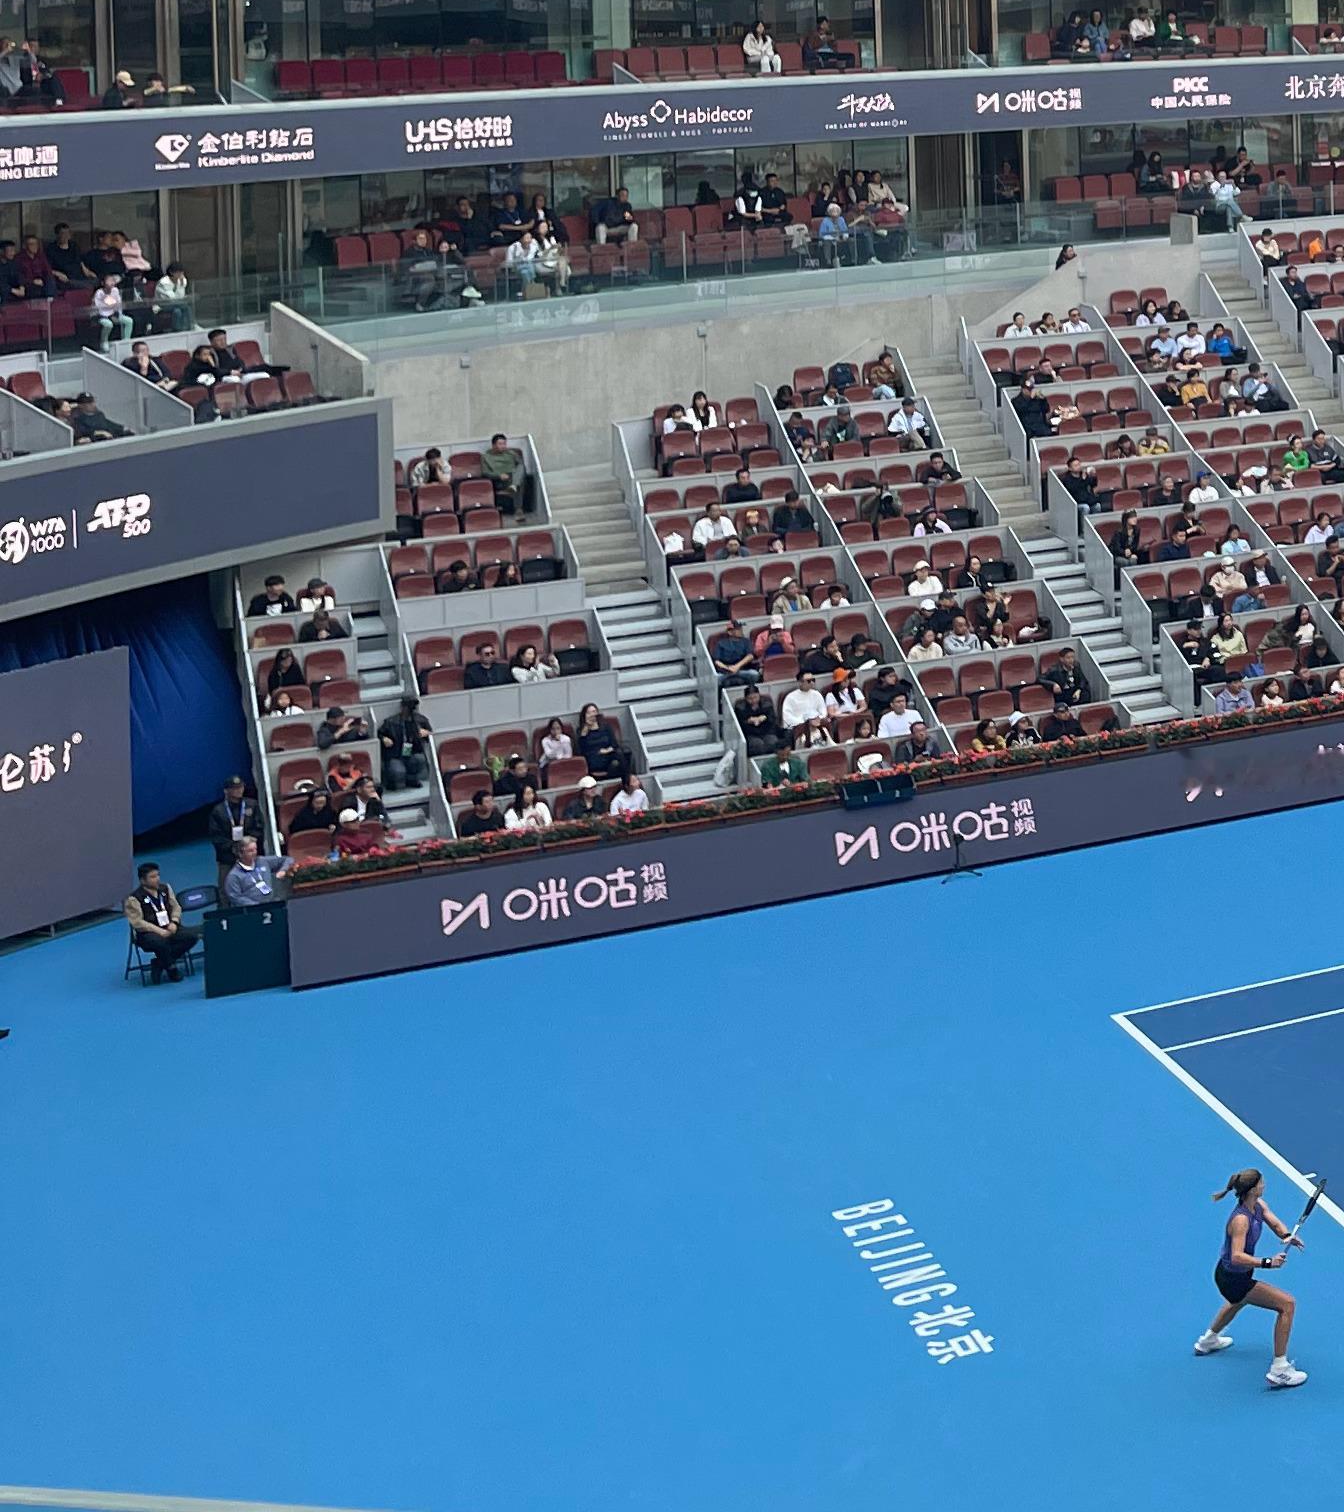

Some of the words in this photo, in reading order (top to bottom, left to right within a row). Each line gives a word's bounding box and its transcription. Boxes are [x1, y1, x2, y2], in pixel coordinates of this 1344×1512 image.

[1173, 76, 1209, 94] PICC
[1150, 93, 1232, 110] 中国人民保险
[602, 111, 649, 133] Abyss
[674, 105, 754, 125] Habidecor
[197, 154, 259, 168] Kimberlite
[260, 149, 315, 163] Diamond
[24, 165, 58, 179] BEER
[86, 493, 151, 537] ATP
[29, 516, 67, 538] WTA
[123, 519, 151, 538] 500
[30, 533, 65, 555] 1000
[832, 1198, 958, 1306] BEIJING
[910, 1305, 995, 1365] 北京
